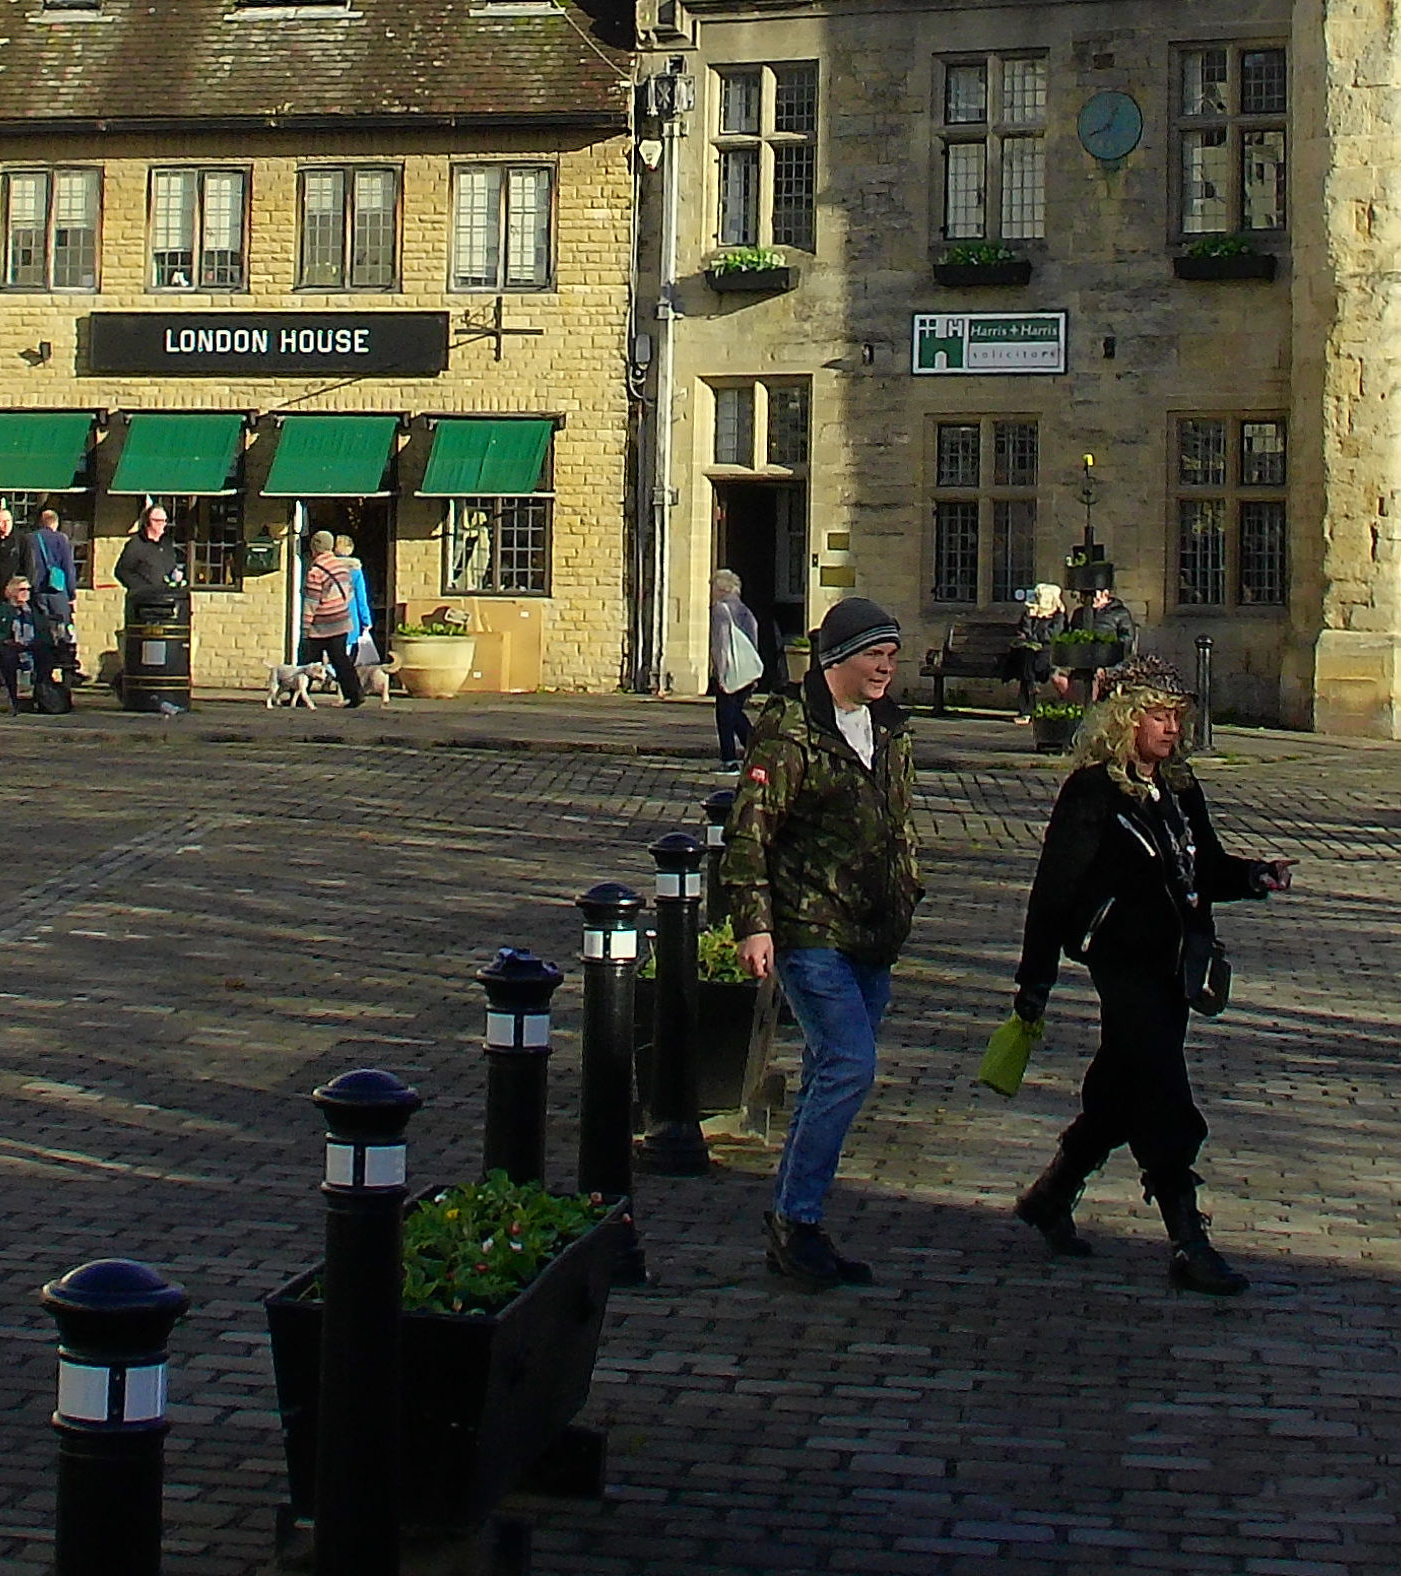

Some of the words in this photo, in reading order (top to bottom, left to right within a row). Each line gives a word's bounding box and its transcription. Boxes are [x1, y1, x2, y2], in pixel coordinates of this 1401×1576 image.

[970, 324, 1007, 336] Harris
[1021, 324, 1058, 336] Harris
[165, 328, 268, 354] LONDON
[280, 328, 370, 354] HOUSE
[973, 349, 1056, 359] solicitors
